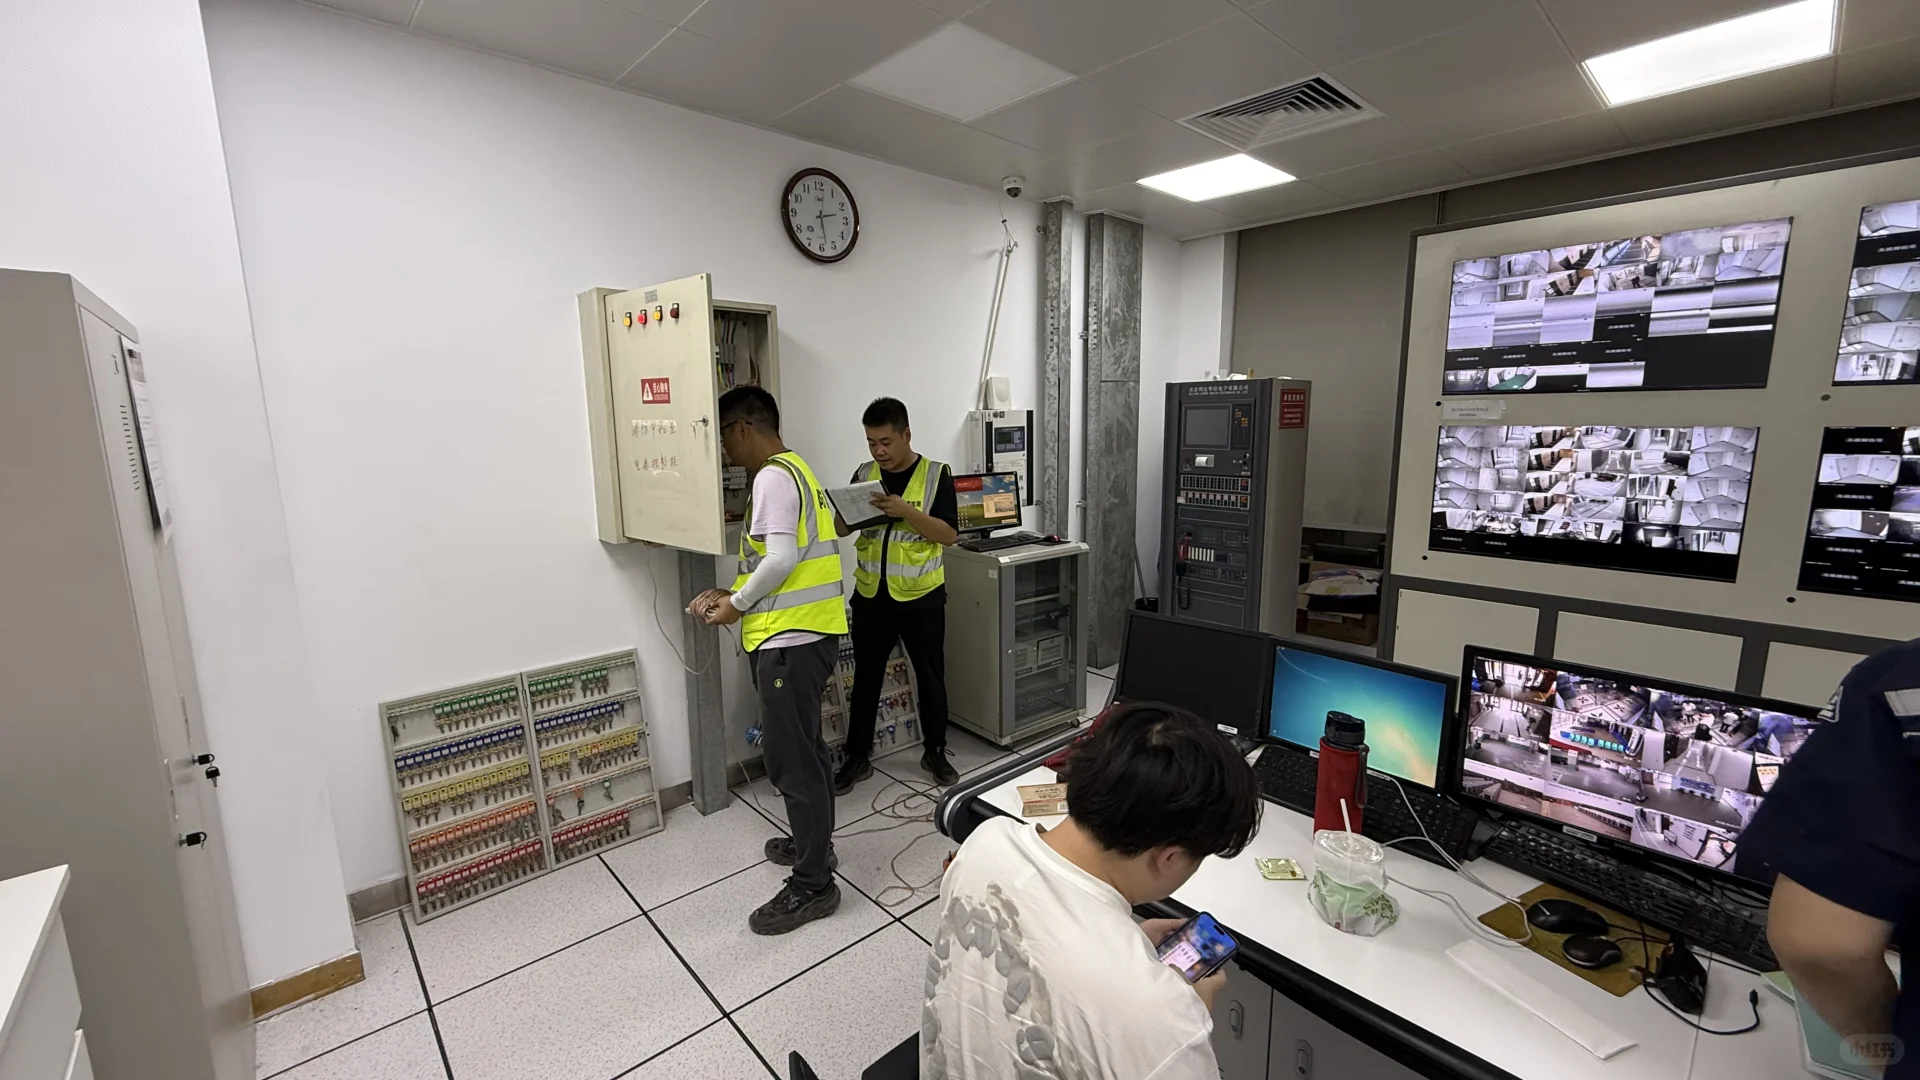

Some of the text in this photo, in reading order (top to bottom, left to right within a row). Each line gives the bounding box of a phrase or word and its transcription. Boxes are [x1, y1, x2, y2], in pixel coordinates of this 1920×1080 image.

[803, 183, 810, 194] 11
[814, 181, 824, 191] 12
[831, 189, 834, 198] 1
[794, 194, 802, 203] 10
[839, 202, 844, 211] 2
[791, 208, 797, 217] 9
[843, 217, 848, 226] 3
[796, 224, 802, 233] 8
[839, 231, 844, 240] 4
[806, 237, 812, 247] 7
[831, 241, 836, 250] 5
[819, 243, 825, 252] 6
